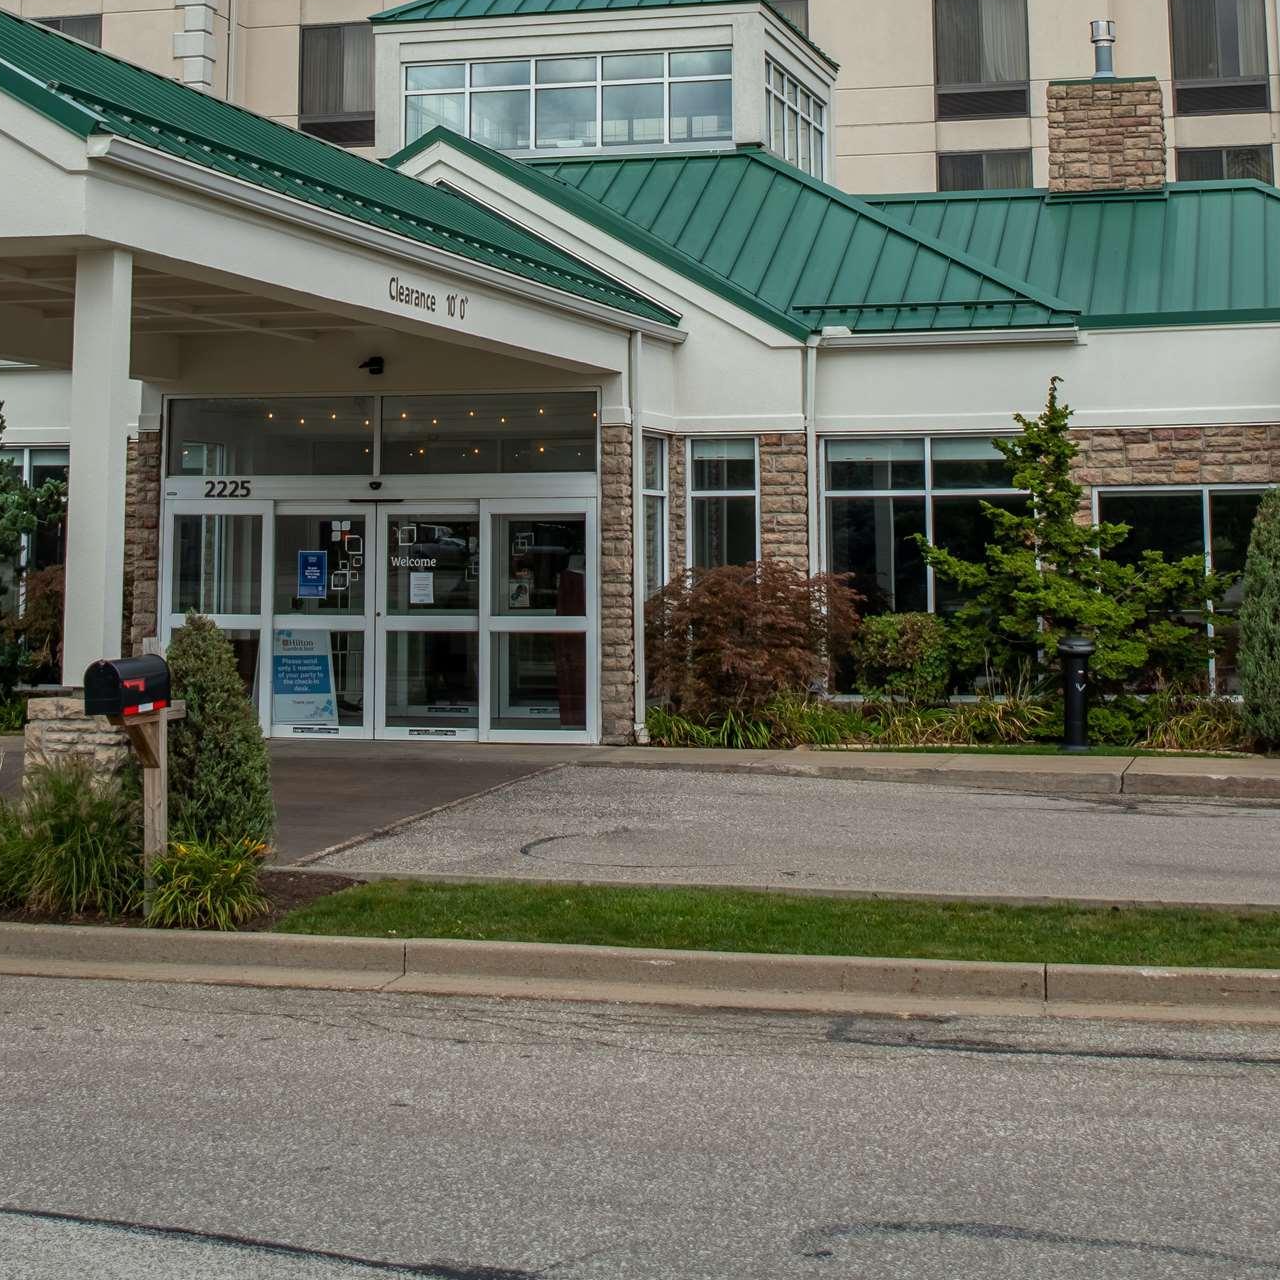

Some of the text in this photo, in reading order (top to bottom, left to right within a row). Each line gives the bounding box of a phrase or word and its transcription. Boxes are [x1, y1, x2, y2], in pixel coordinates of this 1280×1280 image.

[389, 277, 436, 312] Clearance
[204, 480, 251, 498] 2225
[391, 556, 437, 567] Welcome
[289, 639, 314, 647] Hilton
